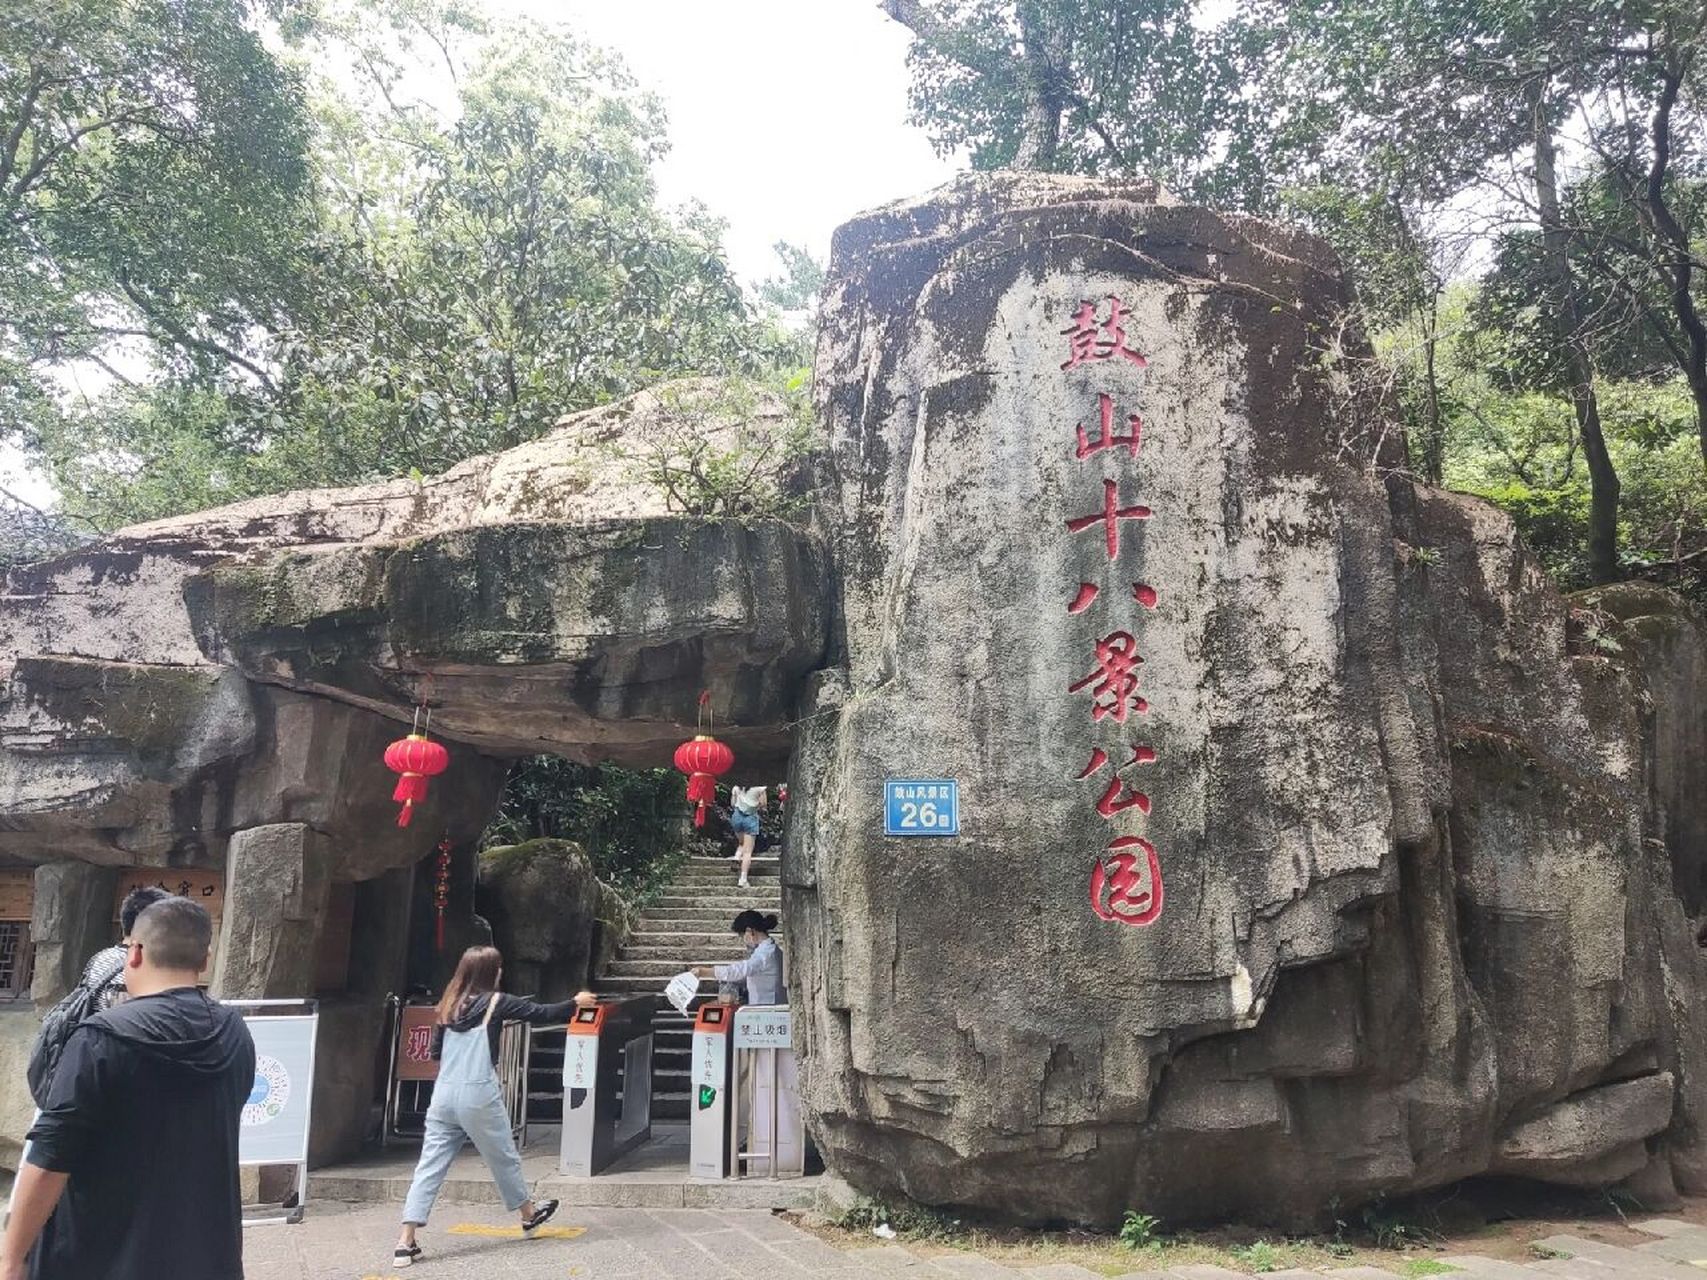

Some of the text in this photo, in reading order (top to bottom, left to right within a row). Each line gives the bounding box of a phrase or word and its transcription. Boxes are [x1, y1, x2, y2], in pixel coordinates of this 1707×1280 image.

[1060, 295, 1164, 926] 鼓山十八景公园
[407, 1025, 432, 1062] 现
[741, 1024, 787, 1036] 禁止吸烟
